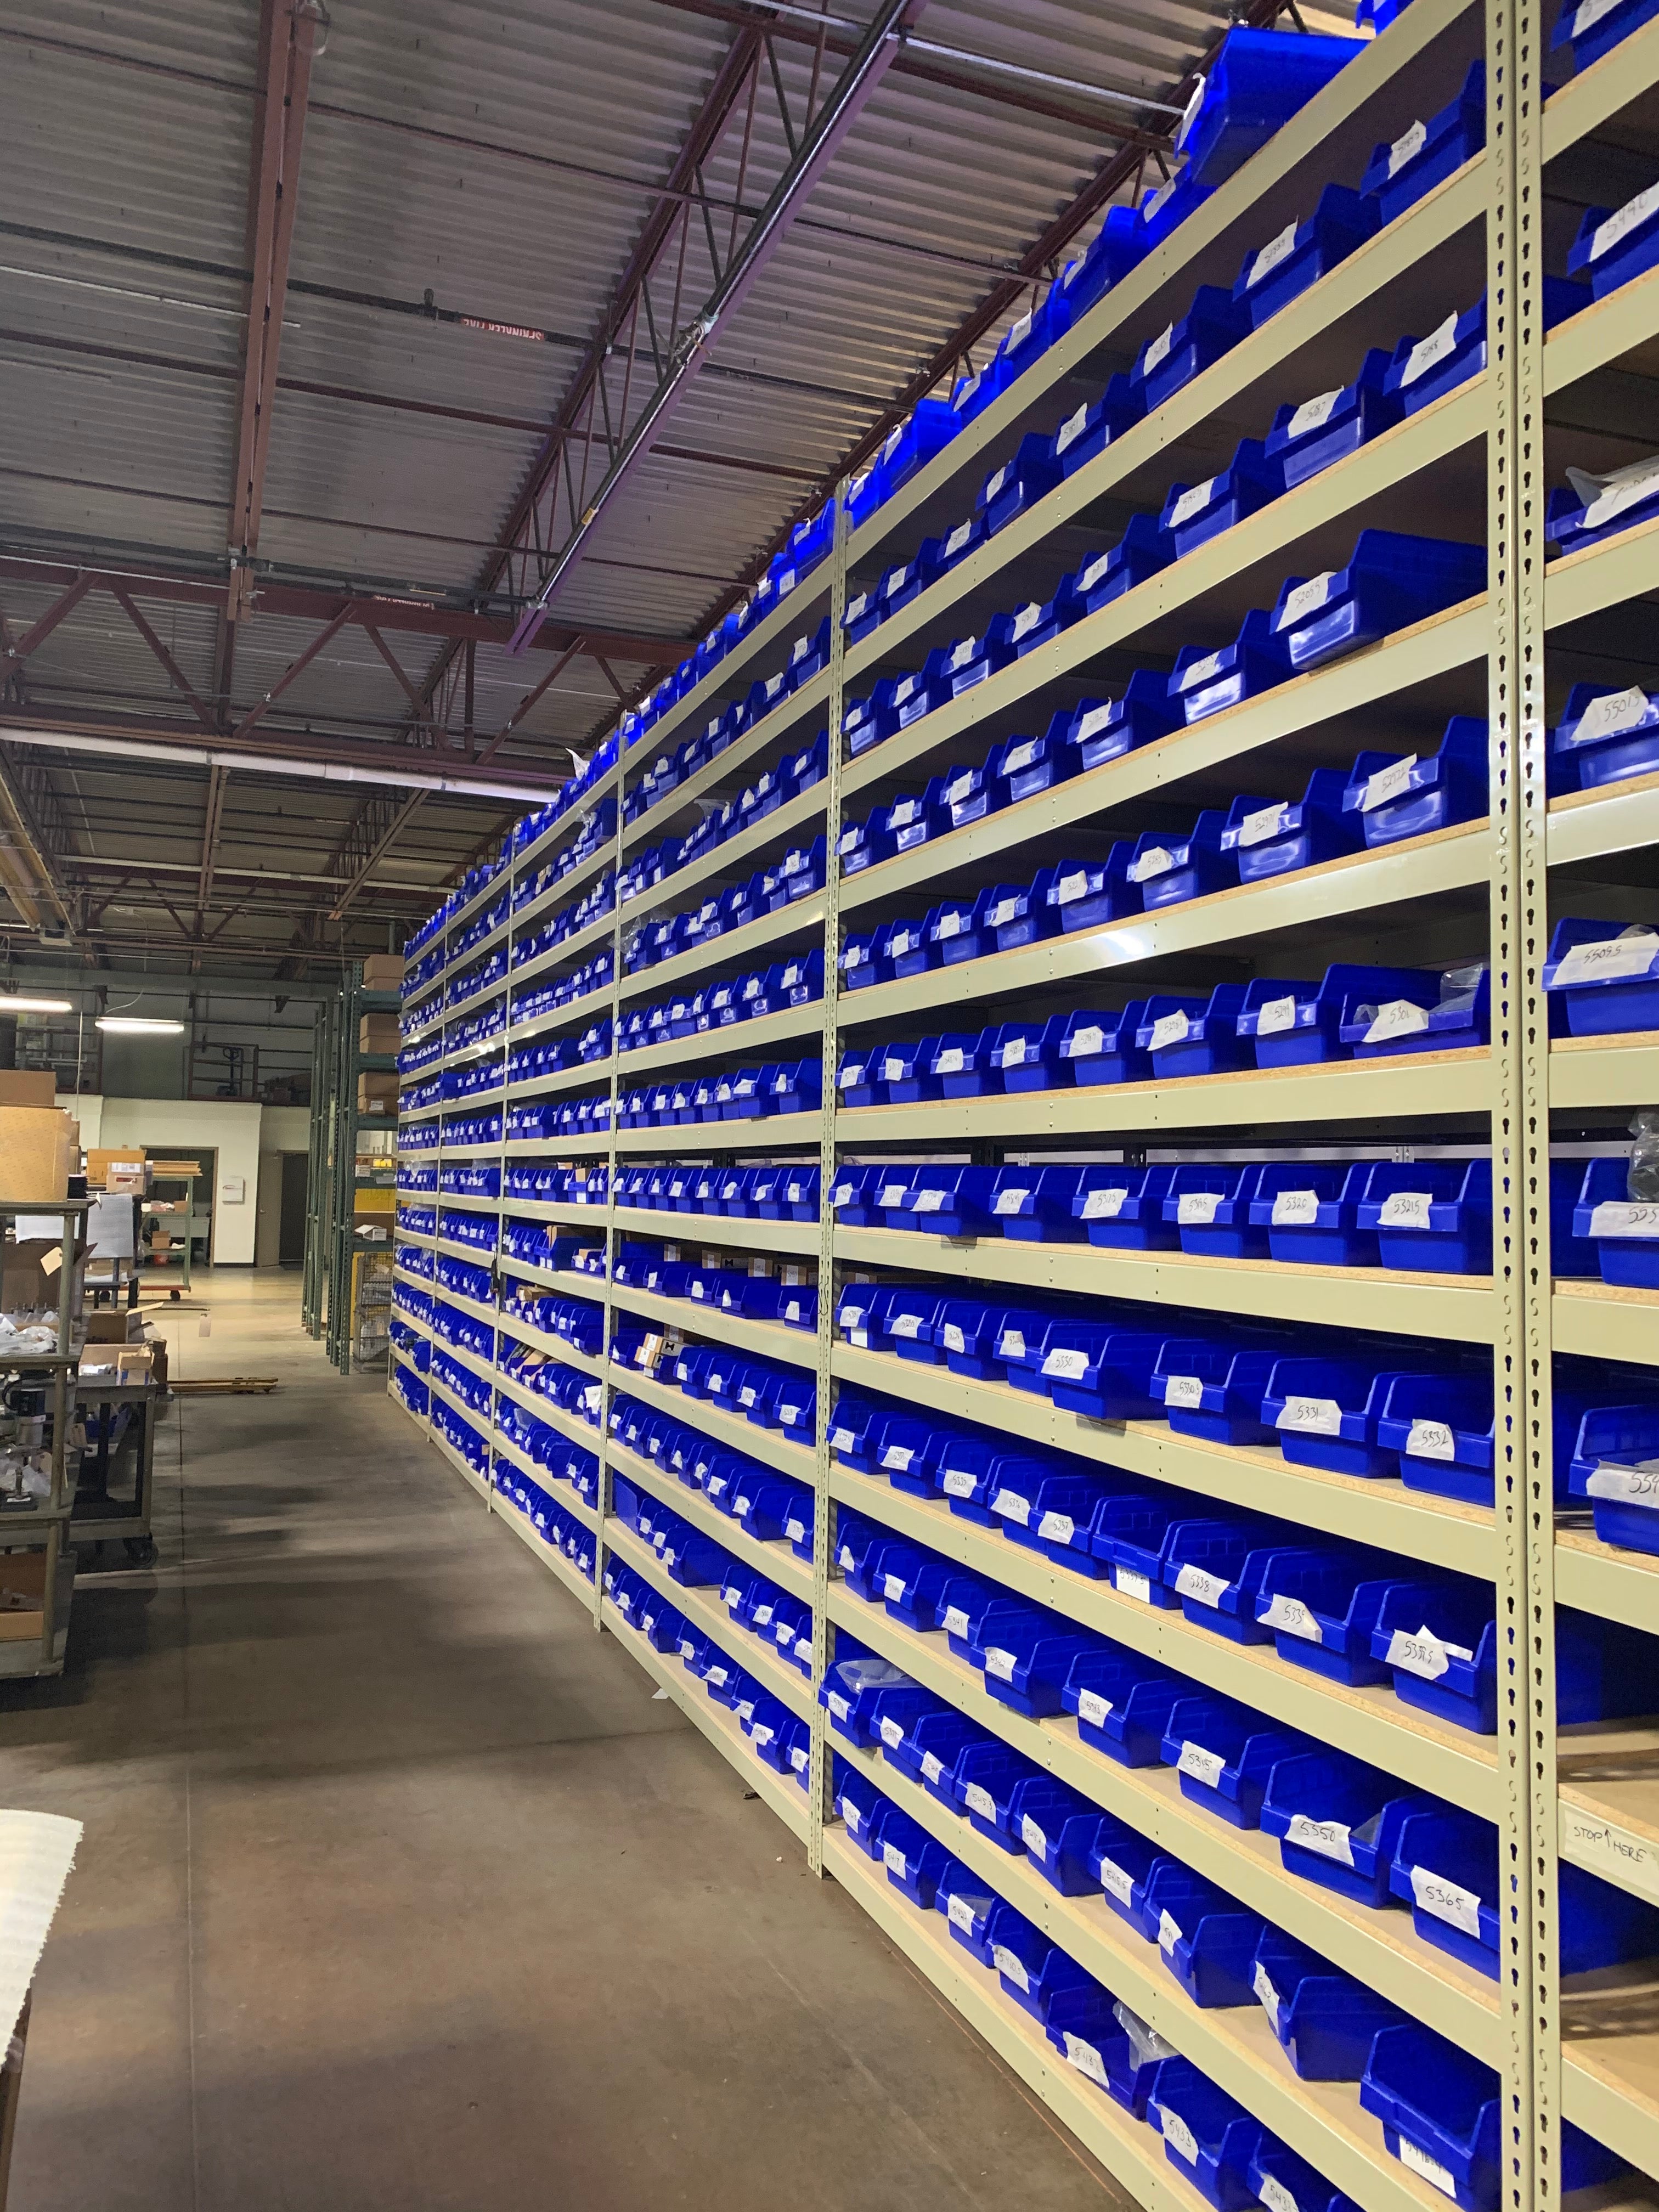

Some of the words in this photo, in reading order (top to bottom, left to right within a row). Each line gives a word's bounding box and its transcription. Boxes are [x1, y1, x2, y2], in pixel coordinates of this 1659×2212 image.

[1295, 580, 1321, 609] 52055
[1286, 1196, 1307, 1211] 5320
[1393, 1199, 1420, 1215] 53215
[1055, 1355, 1074, 1369] 5330
[1297, 1404, 1319, 1422] 5331
[1421, 1429, 1449, 1448] 5332
[1053, 1518, 1070, 1531] 5337
[1190, 1574, 1211, 1593] 5338
[1188, 1753, 1214, 1771] 5345
[1573, 1826, 1602, 1842] STOP
[1613, 1841, 1647, 1863] HERE
[1425, 1886, 1465, 1911] 5365
[1169, 2119, 1192, 2148] 5433
